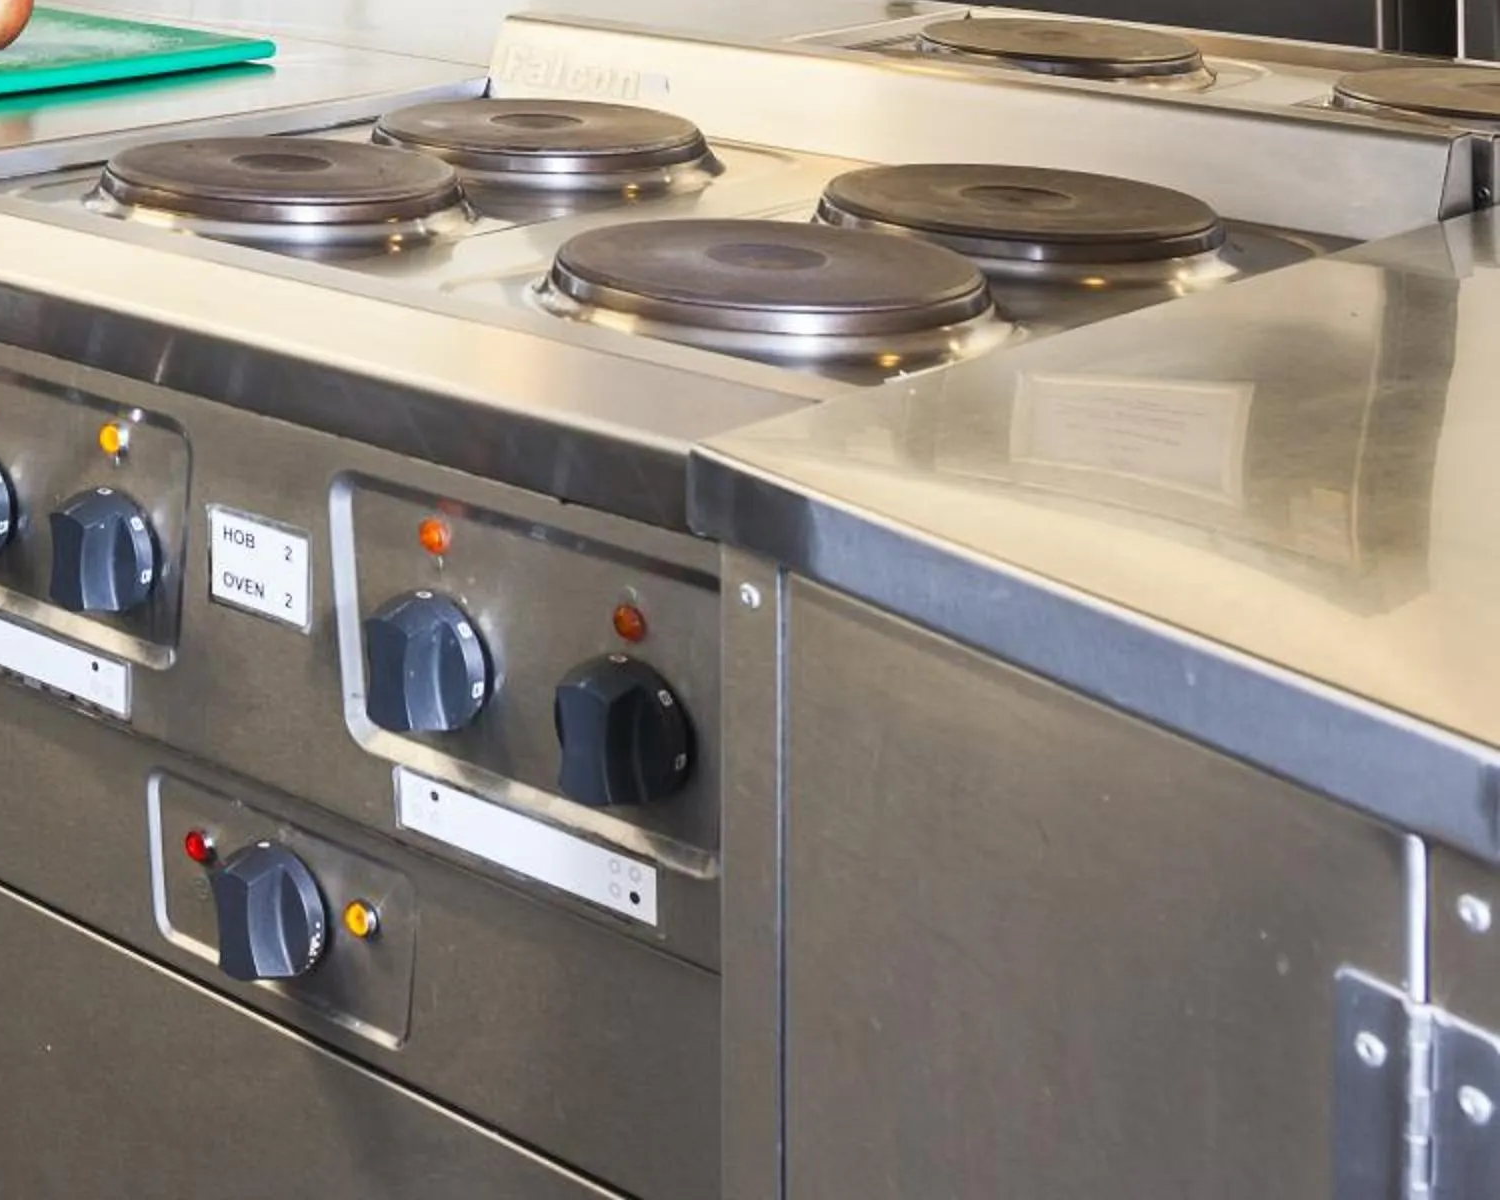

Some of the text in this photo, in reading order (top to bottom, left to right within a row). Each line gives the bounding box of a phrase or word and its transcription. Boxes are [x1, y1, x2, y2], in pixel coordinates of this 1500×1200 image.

[223, 524, 293, 561] HOB 2
[223, 571, 293, 609] OVEN 2
